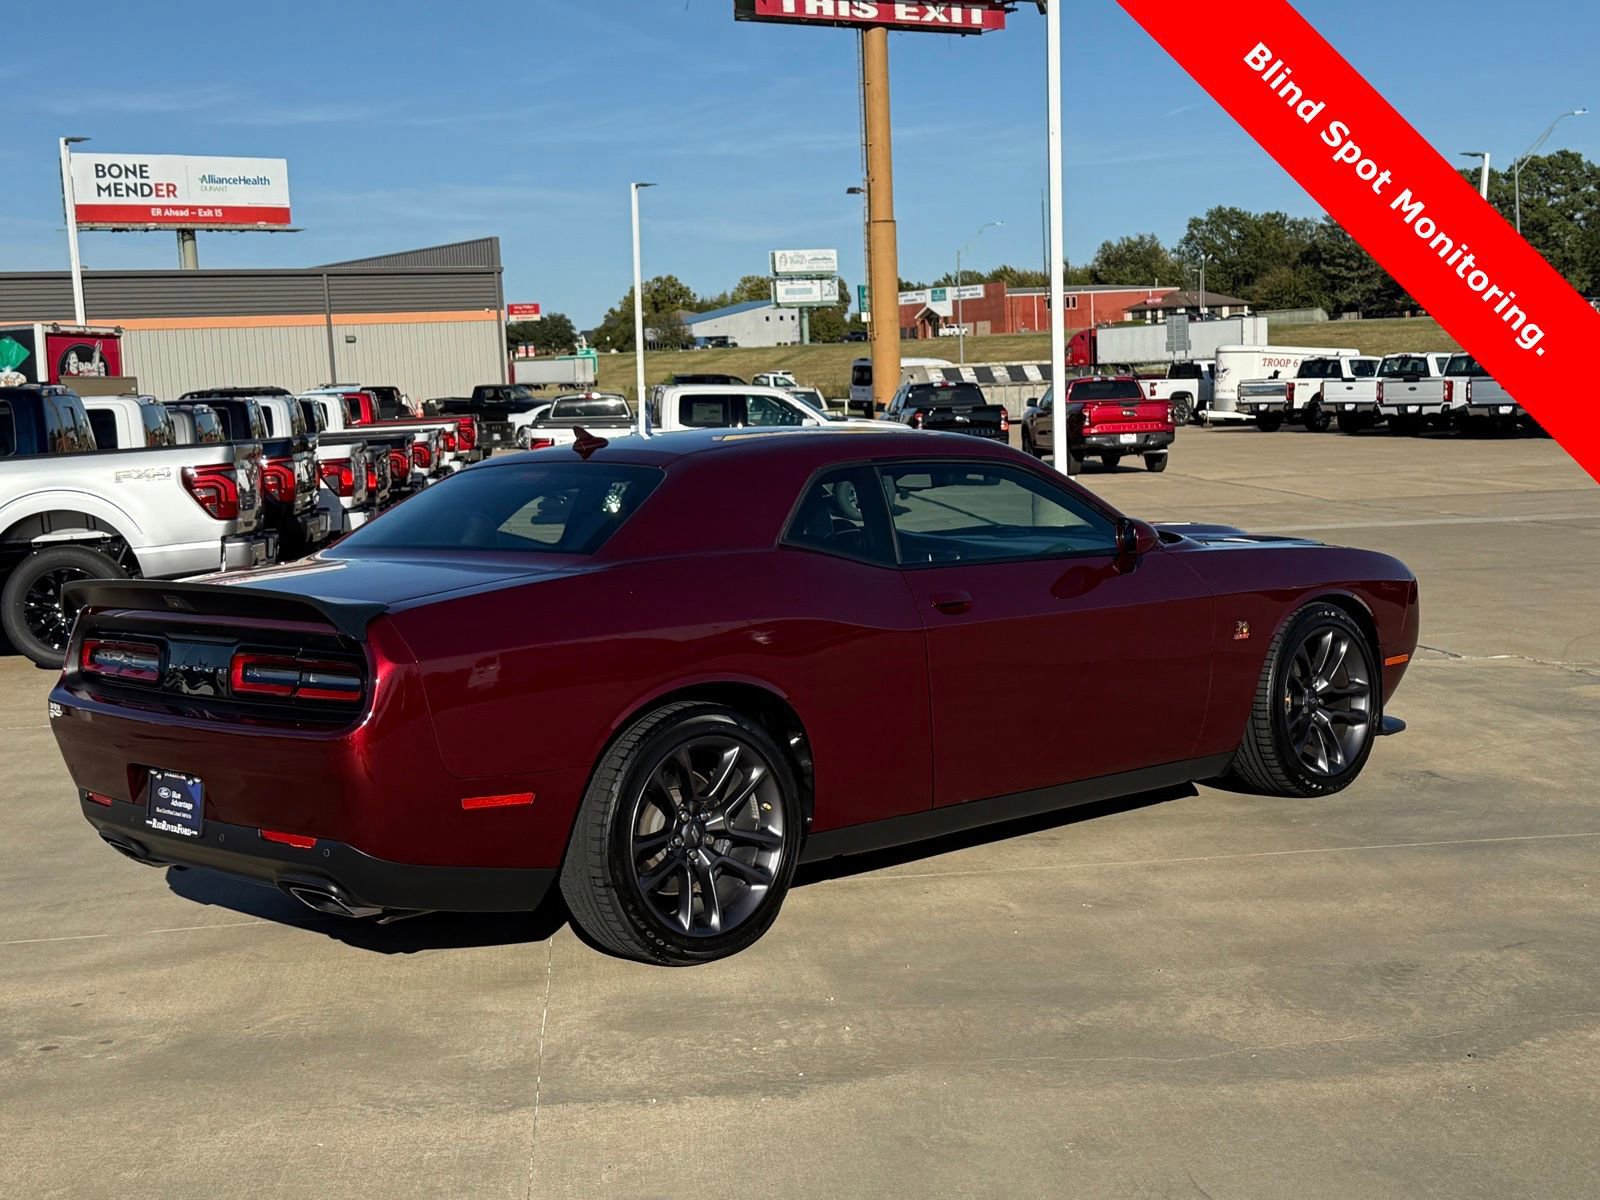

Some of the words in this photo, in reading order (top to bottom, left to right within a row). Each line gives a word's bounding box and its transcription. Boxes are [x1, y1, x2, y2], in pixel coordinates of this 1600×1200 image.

[781, 0, 879, 19] THIS
[894, 1, 989, 25] EXIT
[94, 163, 149, 179] BONE
[200, 174, 270, 186] AllianceHealth
[96, 183, 177, 198] MENDER
[151, 208, 162, 217] ER
[164, 208, 189, 217] Ahead
[198, 209, 213, 217] Exit
[215, 209, 223, 217] 15
[1262, 358, 1291, 367] TROOP
[1293, 358, 1299, 368] 6
